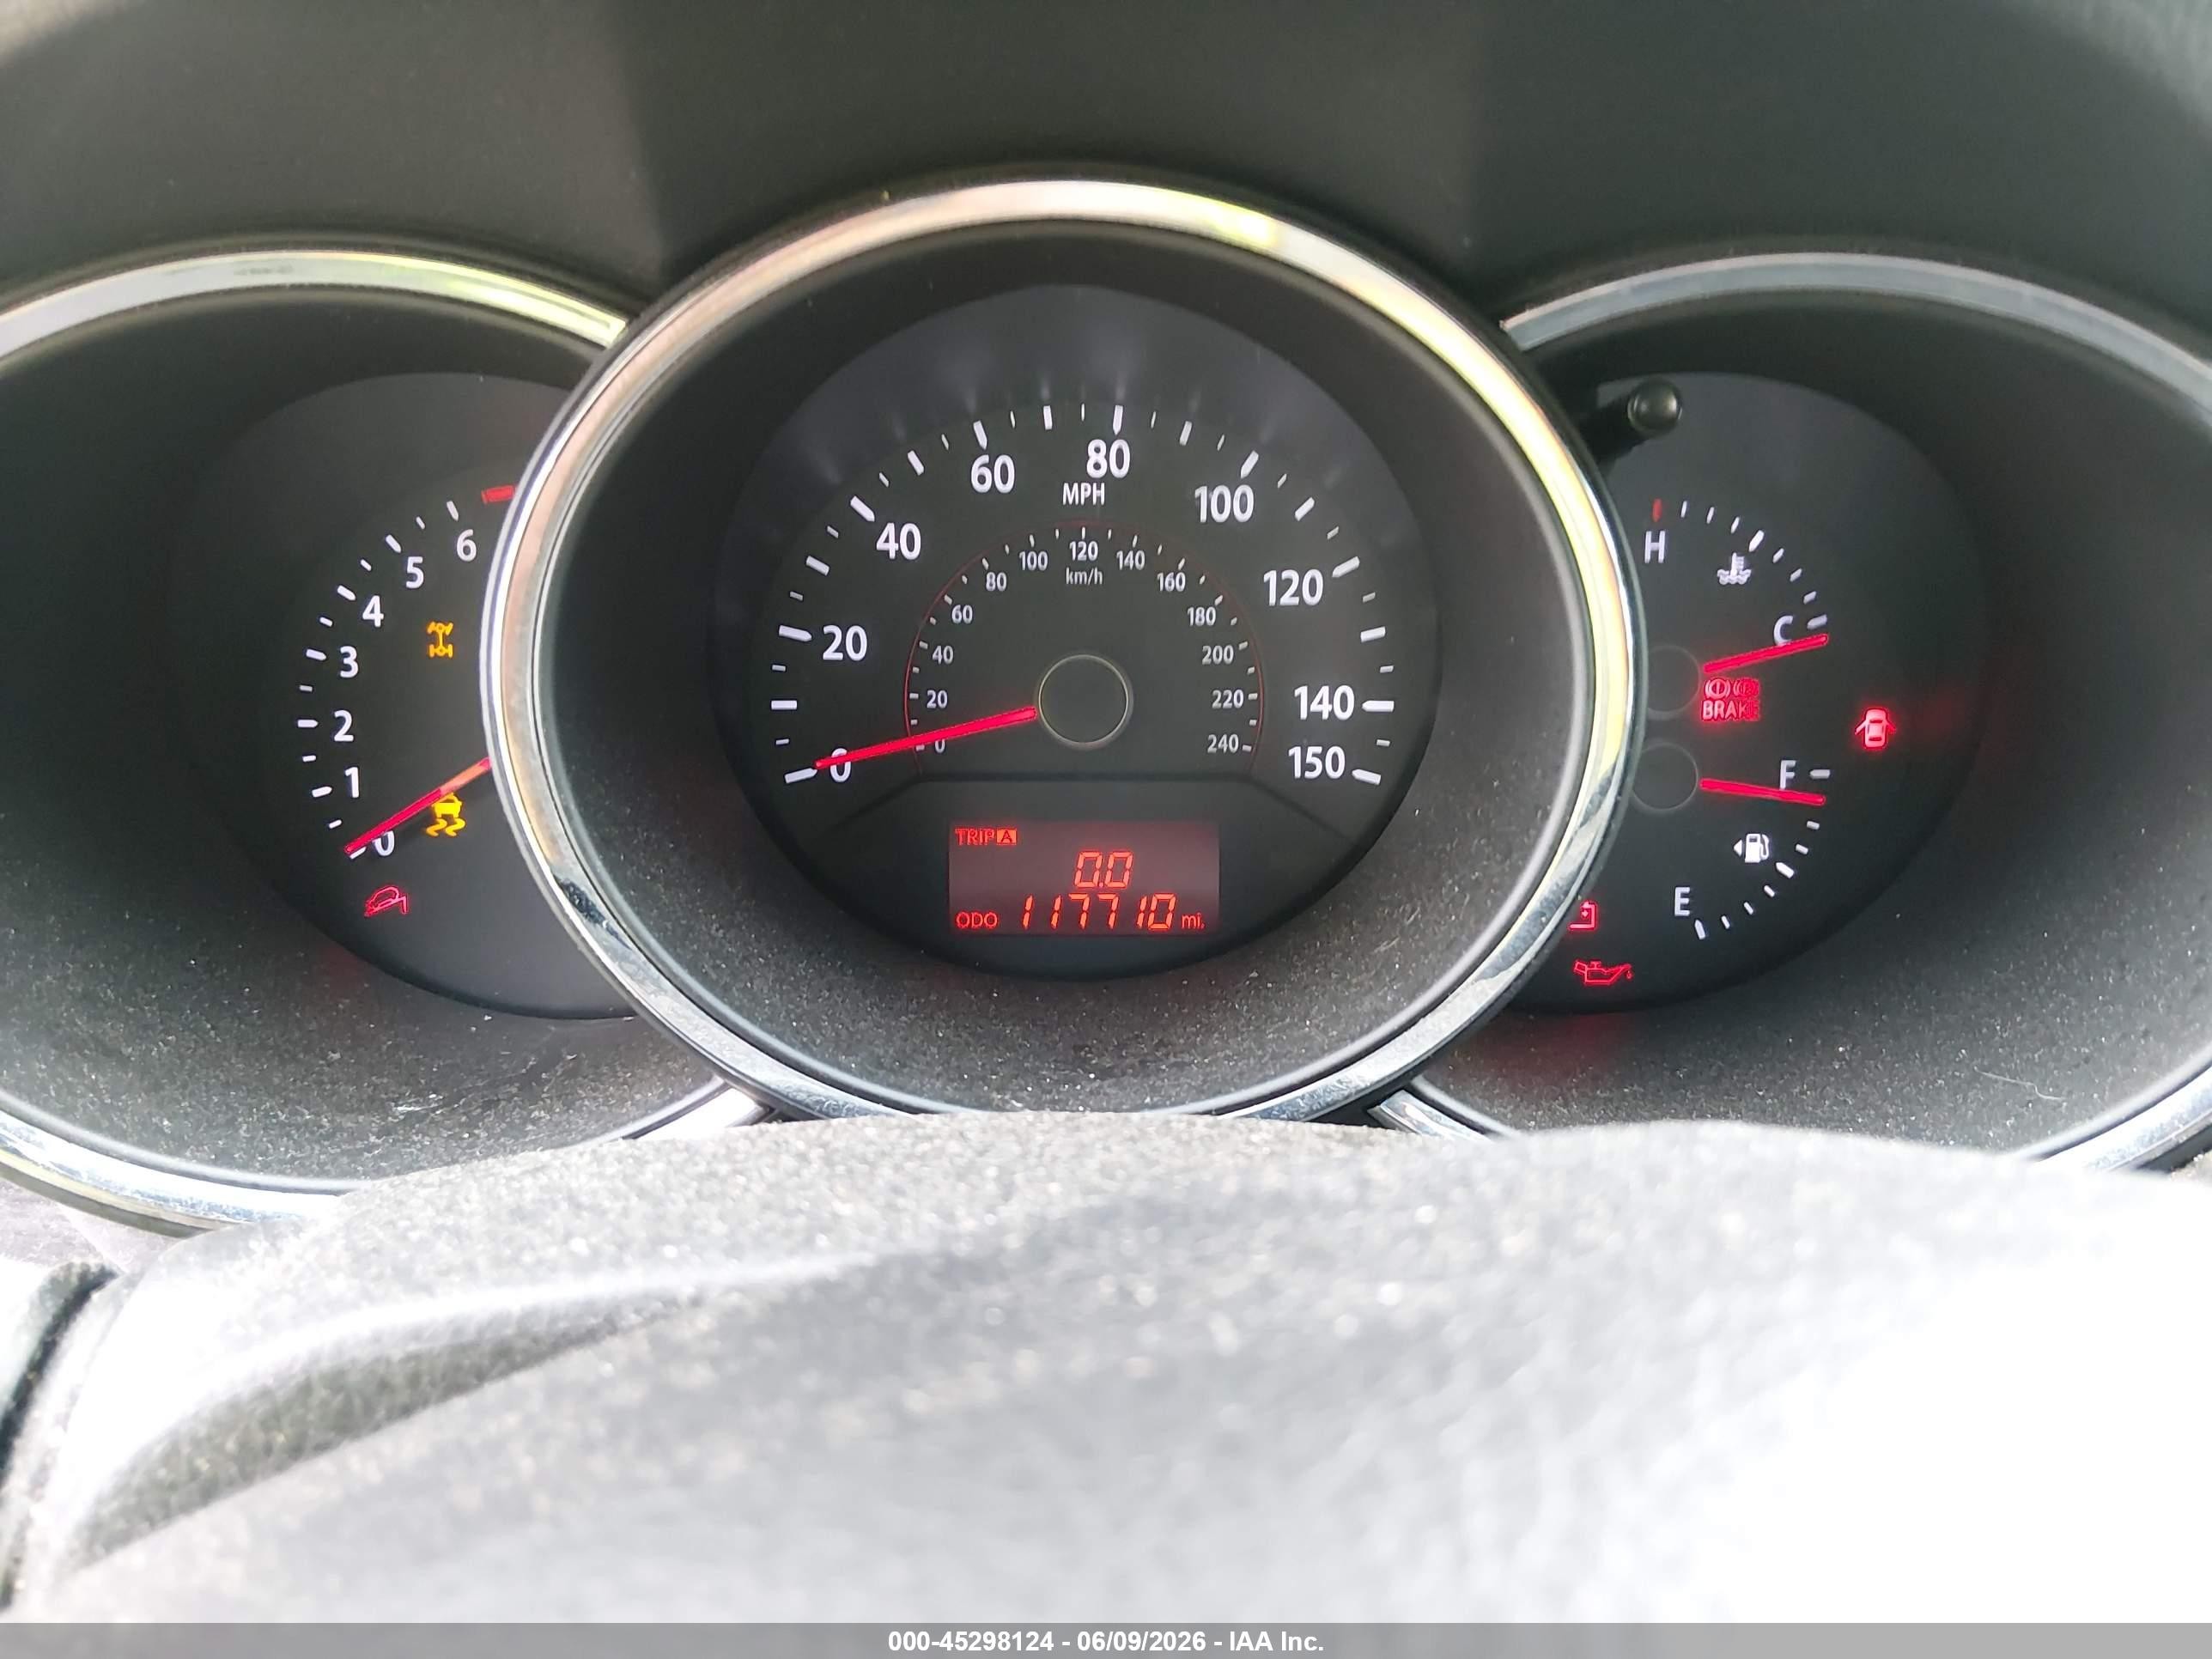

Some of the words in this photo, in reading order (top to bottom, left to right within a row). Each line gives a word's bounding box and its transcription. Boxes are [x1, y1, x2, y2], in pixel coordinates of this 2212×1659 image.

[970, 455, 1015, 493] 60
[1086, 441, 1130, 478] 80
[1062, 483, 1105, 506] MPH
[1194, 486, 1254, 522] 100
[457, 530, 477, 561] 6
[876, 524, 921, 561] 40
[1069, 541, 1098, 562] 120
[1644, 531, 1665, 562] H
[406, 556, 424, 588] 5
[1018, 551, 1048, 571] 100
[1116, 551, 1146, 570] 140
[985, 573, 1007, 592] 80
[1066, 567, 1103, 586] km/h
[1158, 573, 1186, 592] 160
[1264, 570, 1323, 606] 120
[362, 596, 384, 626] 4
[951, 605, 973, 625] 60
[1188, 607, 1217, 626] 180
[823, 626, 867, 662] 20
[1773, 616, 1793, 645] C
[340, 646, 359, 678] 3
[932, 645, 954, 665] 40
[1202, 645, 1234, 665] 200
[927, 689, 948, 708] 20
[1212, 689, 1244, 708] 220
[1294, 686, 1354, 720] 140
[333, 710, 354, 741] 2
[1207, 734, 1239, 754] 240
[830, 747, 852, 783] 0
[1288, 747, 1346, 781] 150
[1780, 760, 1796, 790] F
[345, 767, 359, 798] 1
[373, 830, 396, 857] 0
[1074, 851, 1133, 888] 0.0
[955, 912, 998, 927] ODO
[1022, 892, 1176, 930] 117710
[1182, 913, 1205, 928] mi.
[1674, 887, 1690, 916] E
